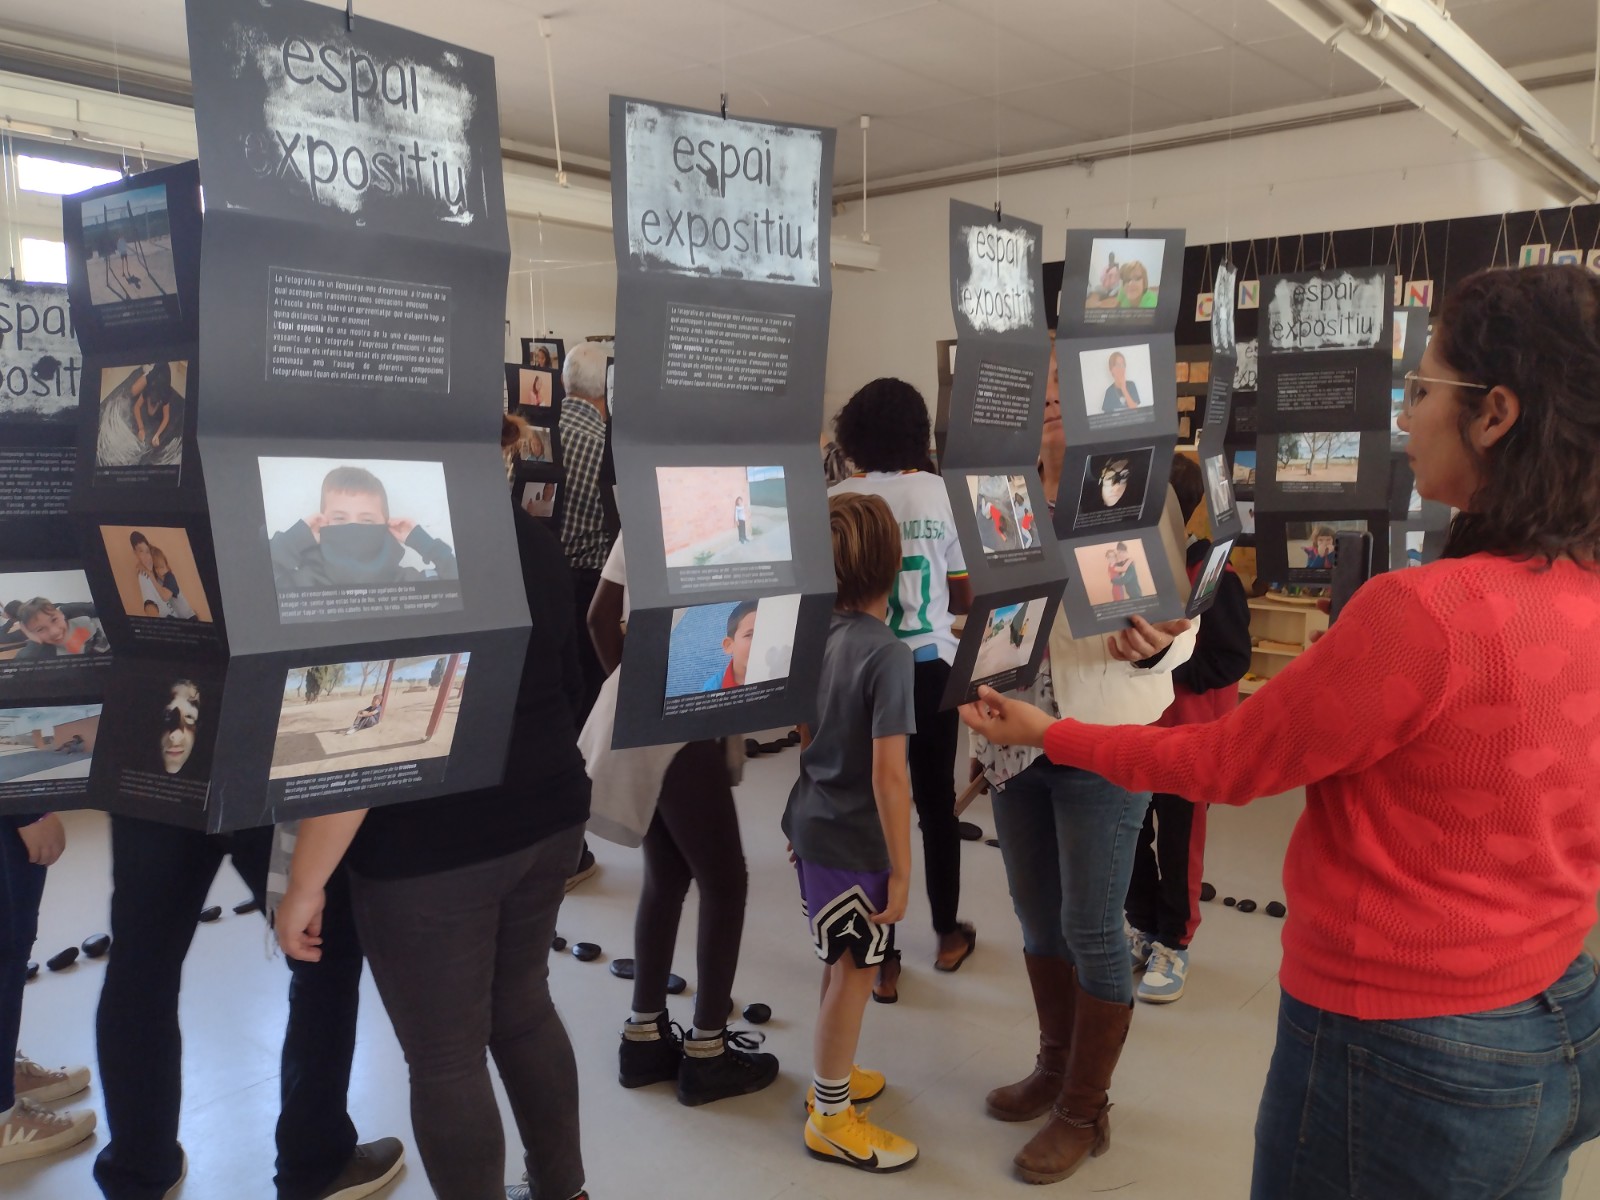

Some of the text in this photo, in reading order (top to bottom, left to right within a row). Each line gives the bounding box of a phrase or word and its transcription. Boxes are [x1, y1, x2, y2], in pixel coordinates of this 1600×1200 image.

[282, 34, 419, 123] espai
[672, 135, 772, 198] espai
[641, 208, 803, 265] expositiu
[976, 230, 1019, 277] espai
[1293, 277, 1354, 310] espai
[1272, 312, 1373, 346] expositiu
[903, 519, 945, 540] MOUSSA
